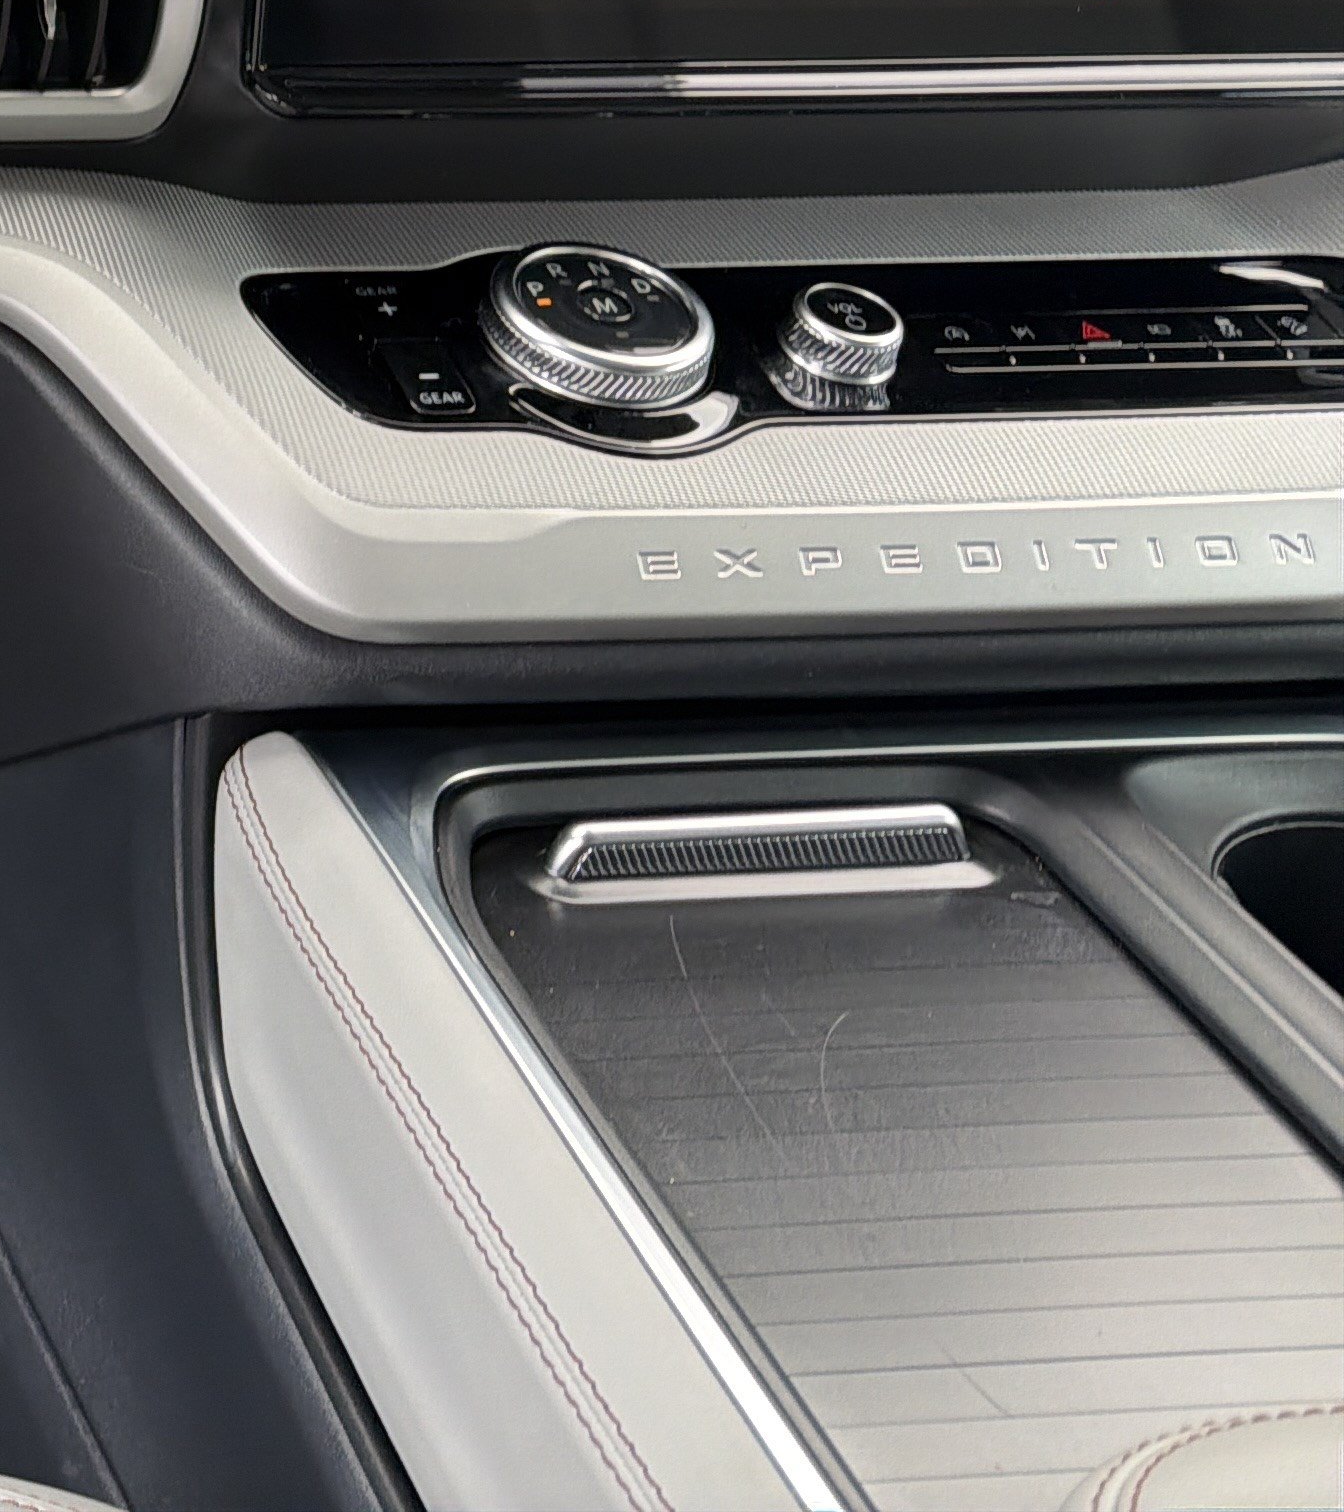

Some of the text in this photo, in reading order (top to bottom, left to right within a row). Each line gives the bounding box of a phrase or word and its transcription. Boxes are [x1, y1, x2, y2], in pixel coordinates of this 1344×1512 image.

[546, 261, 610, 278] R N
[526, 277, 652, 298] P D
[591, 296, 618, 315] M
[419, 390, 465, 405] GEAR
[636, 533, 1315, 582] EXPEDITION
